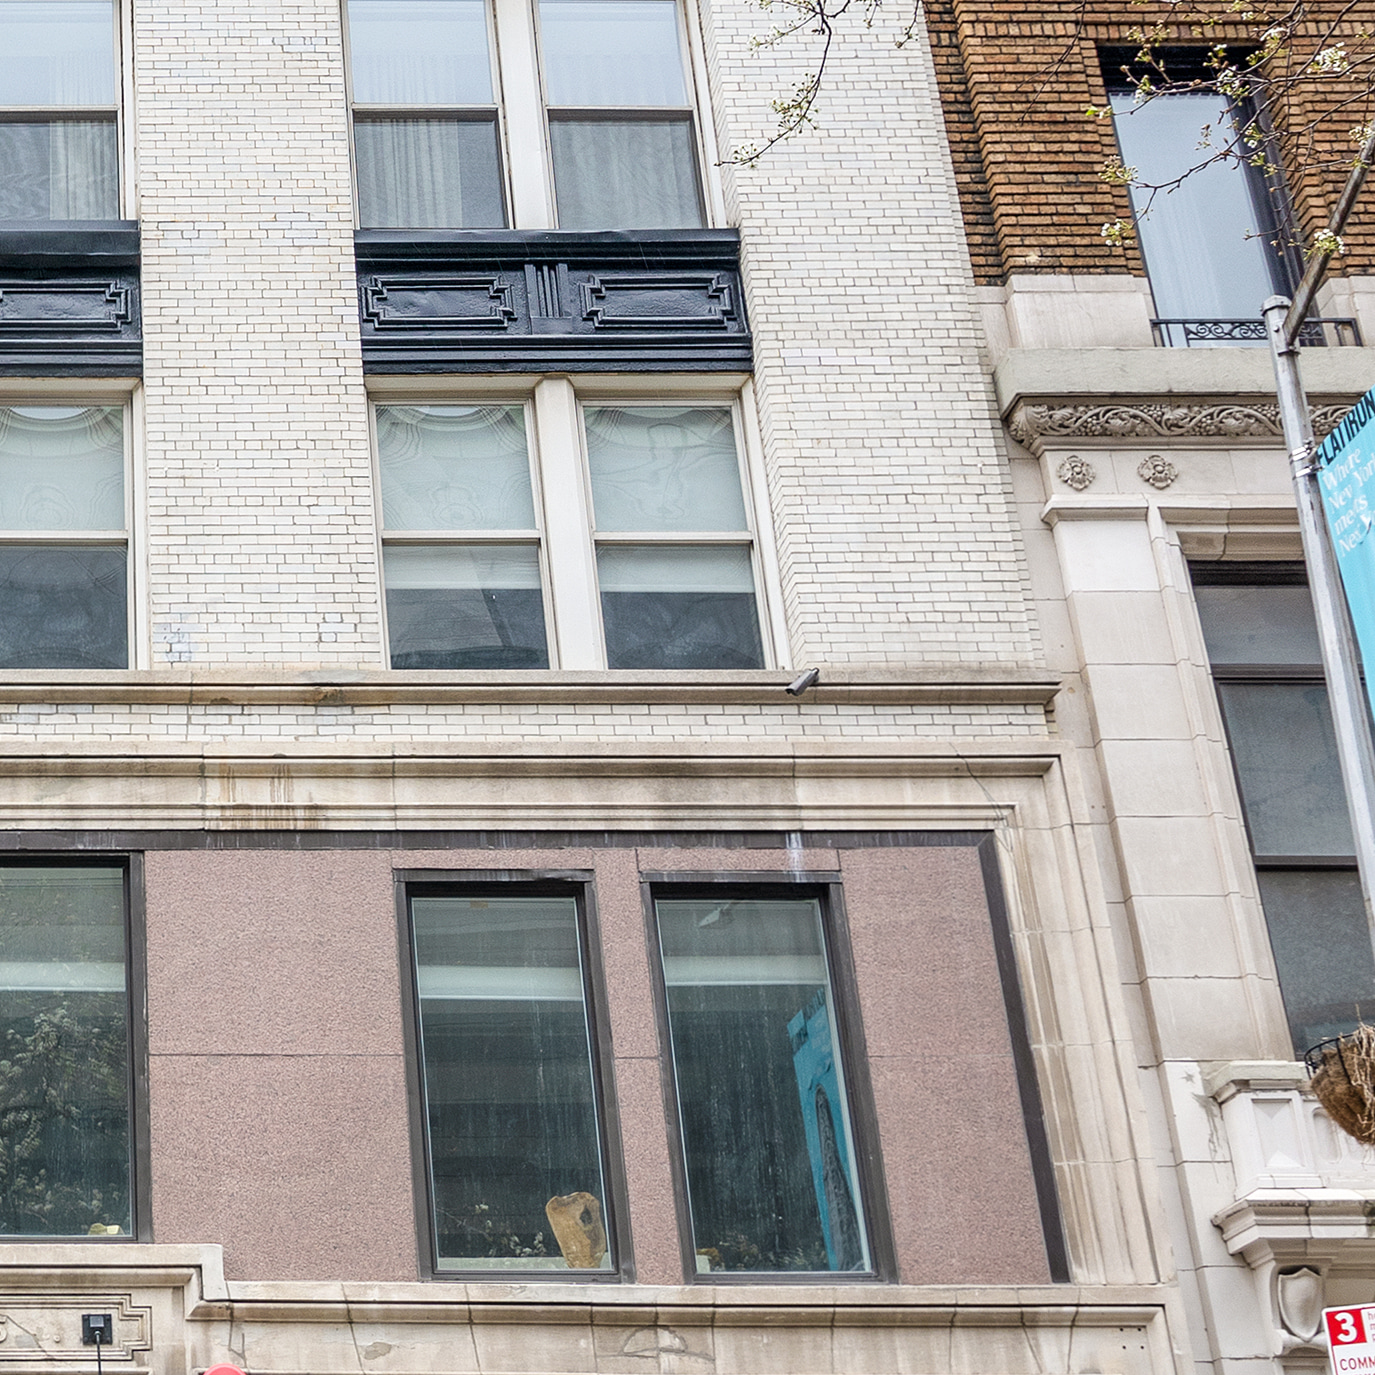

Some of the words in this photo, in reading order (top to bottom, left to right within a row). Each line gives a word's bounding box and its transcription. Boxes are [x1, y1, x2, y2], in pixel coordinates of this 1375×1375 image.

[1316, 389, 1375, 465] FLATIRON
[1322, 448, 1361, 491] Where
[1334, 1312, 1358, 1343] 3
